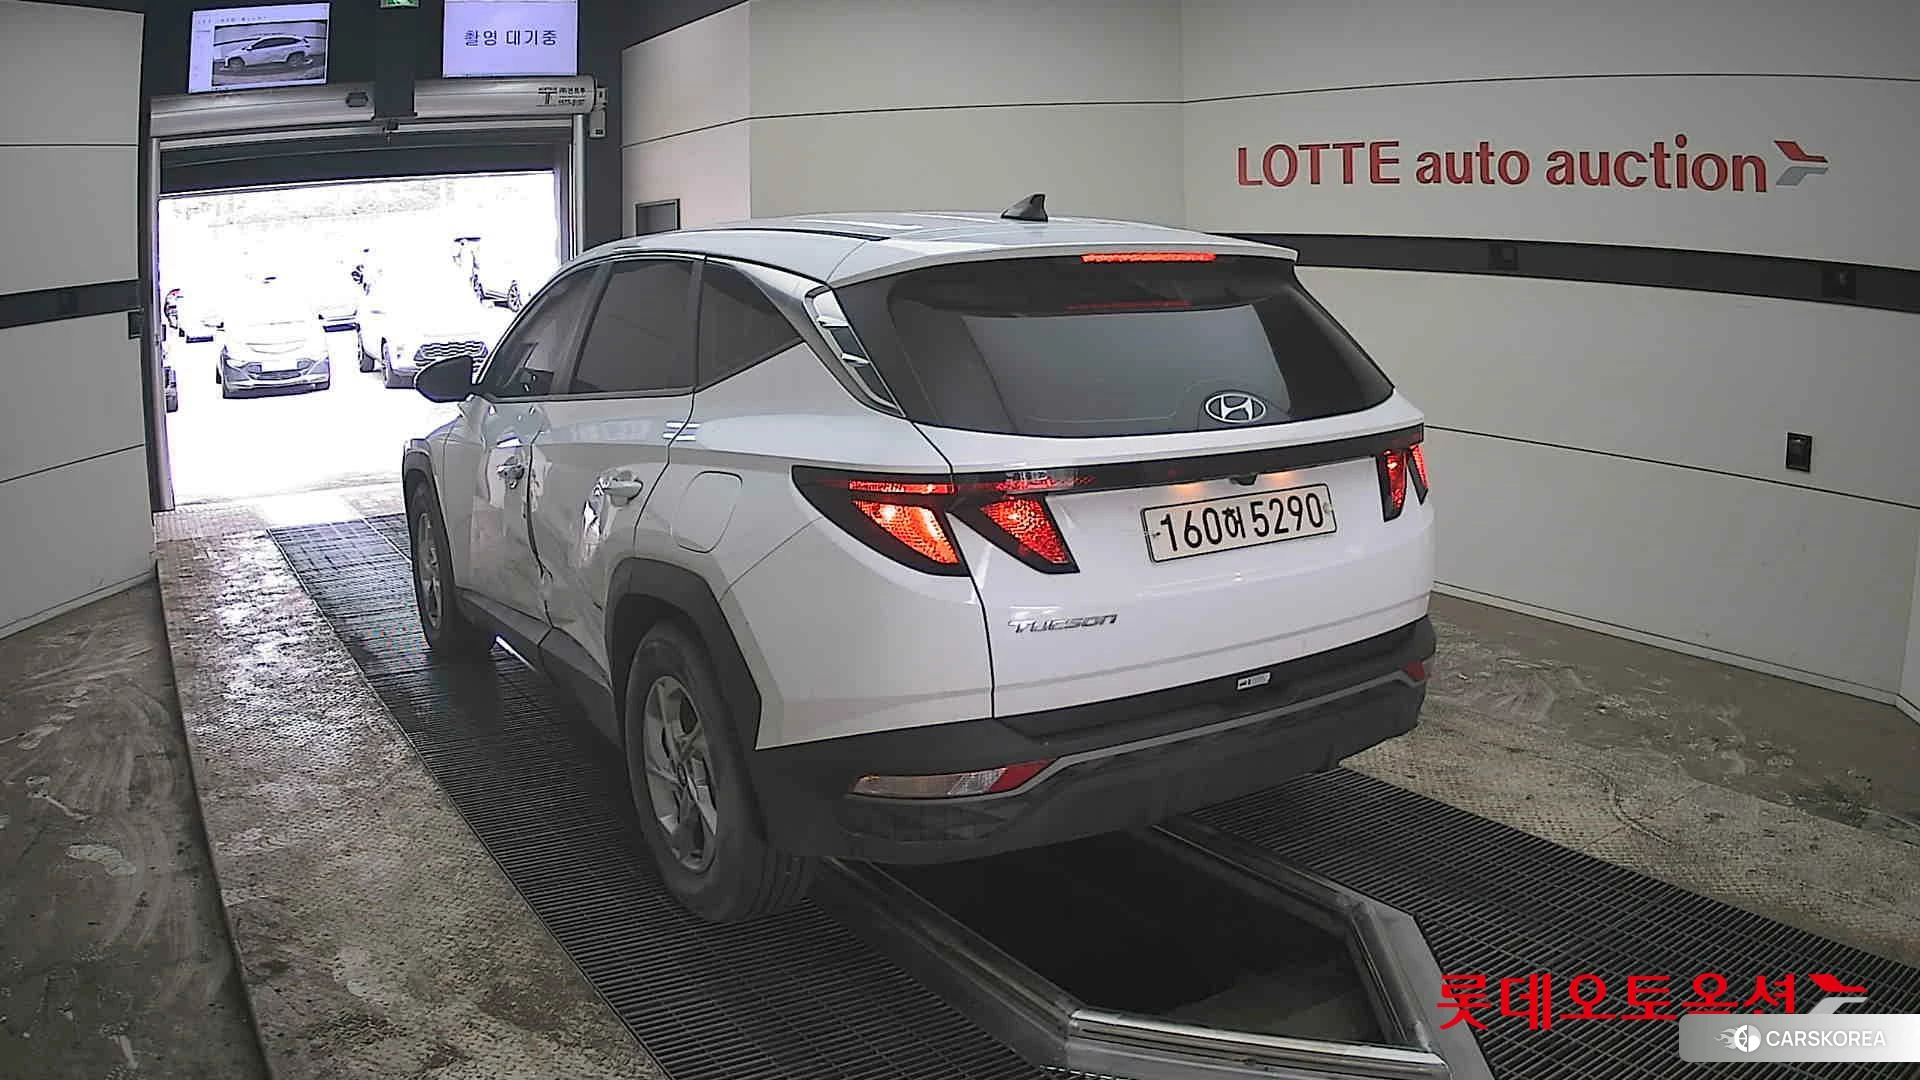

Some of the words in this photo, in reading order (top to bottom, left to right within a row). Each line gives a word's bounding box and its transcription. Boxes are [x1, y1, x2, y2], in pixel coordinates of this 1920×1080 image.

[505, 29, 558, 47] 대기중
[1237, 139, 1400, 188] LOTTE
[1415, 140, 1530, 187] auto
[1545, 133, 1768, 193] auction
[1159, 505, 1246, 552] 160허
[1249, 492, 1325, 538] 5290
